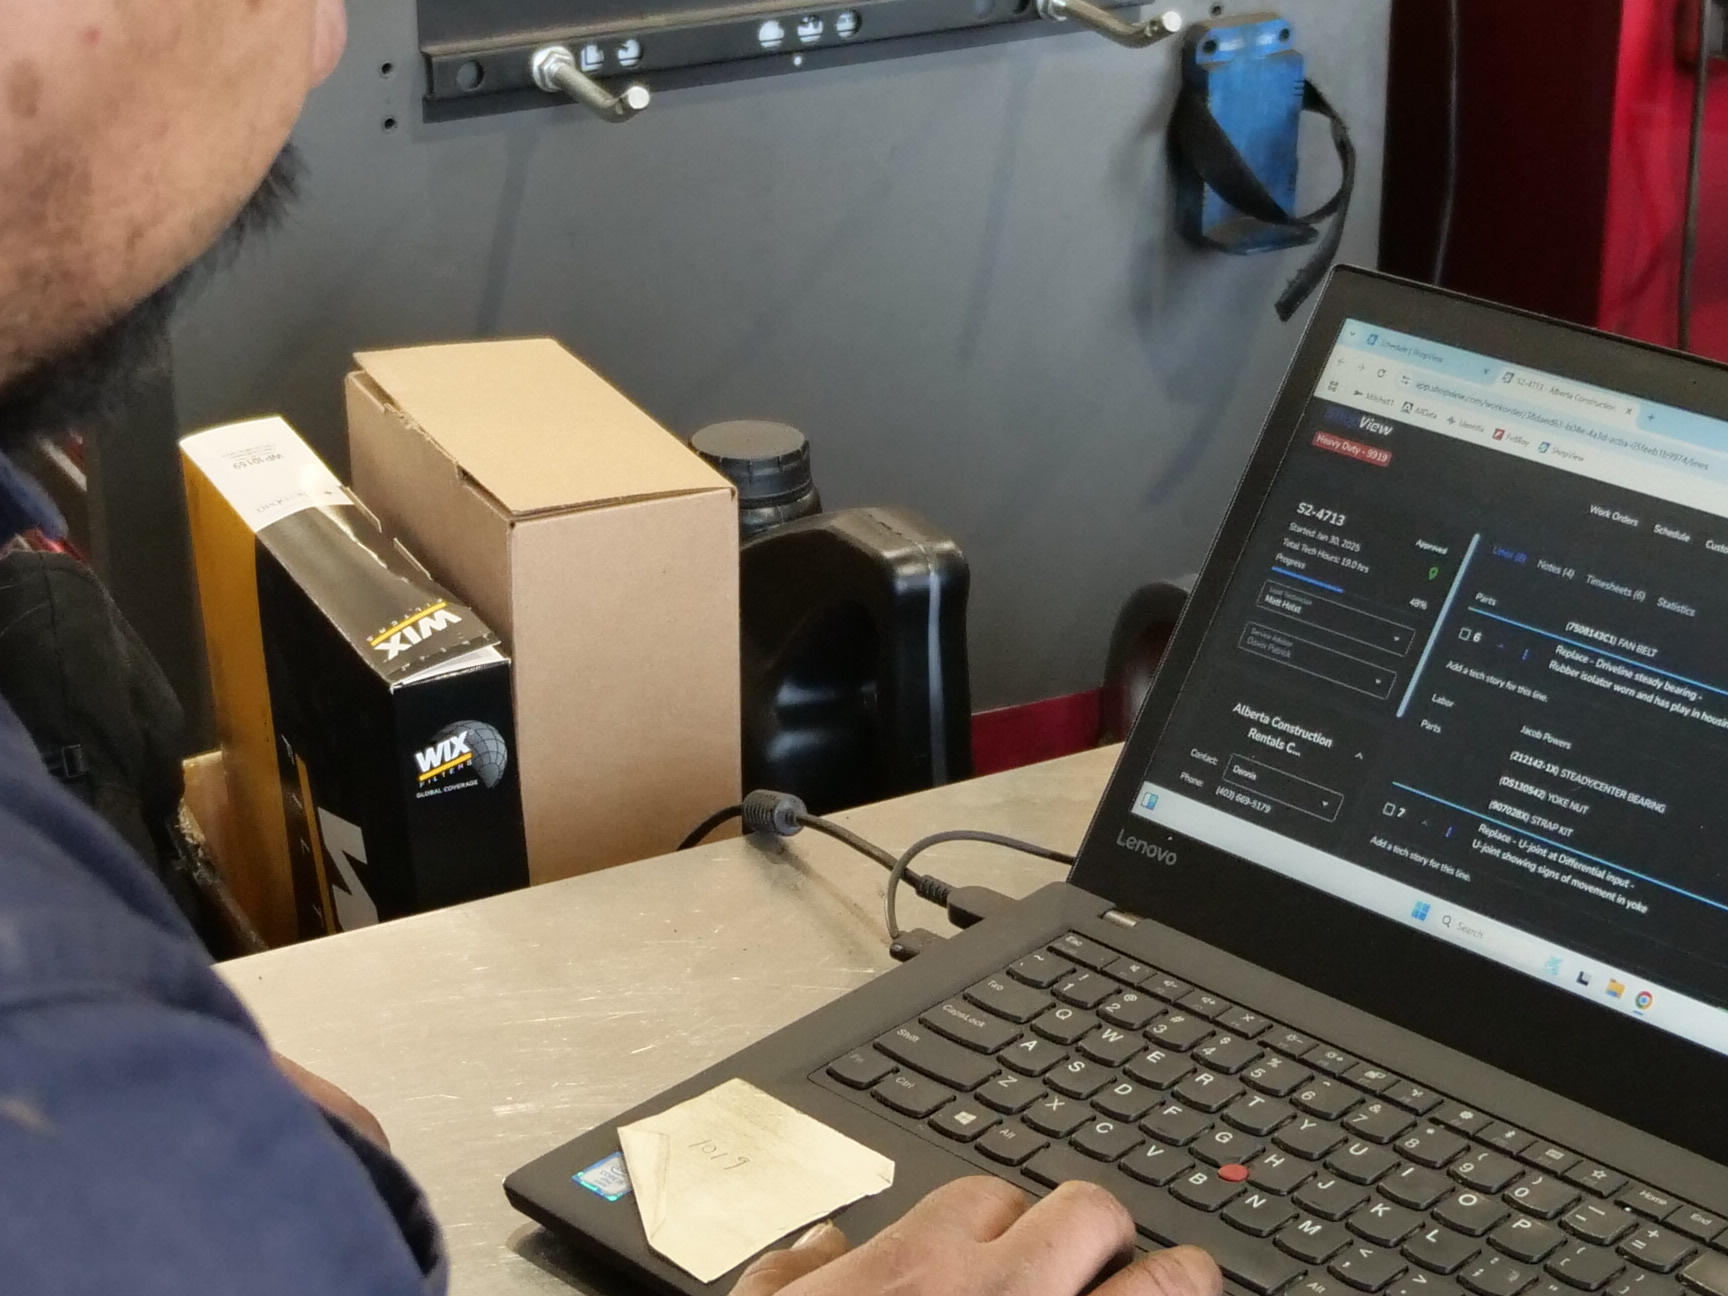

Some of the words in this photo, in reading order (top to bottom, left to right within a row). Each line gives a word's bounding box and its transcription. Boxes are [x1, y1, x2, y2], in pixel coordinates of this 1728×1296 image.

[1548, 386, 1574, 400] Alberta
[1315, 433, 1342, 450] Heavy
[1340, 440, 1361, 456] Duty
[1365, 448, 1389, 463] 9919
[1296, 501, 1346, 527] S2-4713
[1589, 504, 1611, 519] Work
[1611, 510, 1639, 527] Orders
[1315, 531, 1329, 542] Jan
[1340, 538, 1361, 552] 2025
[1653, 523, 1691, 542] Schedule
[1282, 537, 1301, 551] Total
[1300, 543, 1317, 555] Tech
[1316, 549, 1341, 564] Hours:
[1340, 556, 1358, 569] 19.0
[1356, 562, 1370, 574] hrs
[1414, 538, 1448, 555] Approved
[1274, 552, 1306, 570] Progress
[1536, 559, 1562, 575] Notes
[1561, 567, 1575, 580] (4)
[1474, 591, 1497, 606] Parts
[1586, 573, 1633, 597] Timesheets
[1632, 589, 1646, 602] (6)
[1264, 593, 1282, 607] Matt
[1656, 596, 1696, 617] Statistics
[374, 608, 462, 660] WIX
[1617, 637, 1636, 651] FAN
[1635, 643, 1658, 657] BELT
[1445, 660, 1464, 673] Add
[1468, 668, 1486, 681] tech
[1485, 675, 1506, 688] story
[1504, 680, 1517, 691] for
[1516, 684, 1532, 697] this
[1554, 644, 1589, 664] Replace
[1594, 657, 1634, 679] Driveline
[1633, 672, 1664, 690] steady
[1662, 680, 1698, 702] bearing
[1431, 692, 1455, 708] Labor
[1548, 659, 1580, 678] Rubber
[1579, 670, 1613, 689] isolator
[1612, 683, 1636, 697] worn
[1635, 691, 1655, 703] and
[1652, 694, 1671, 709] has
[1668, 702, 1692, 717] play
[1689, 707, 1701, 719] in
[1232, 702, 1270, 725] Alberta
[1270, 715, 1333, 748] Construction
[1420, 718, 1441, 734] Parts
[1247, 727, 1285, 750] Rentals
[1519, 724, 1543, 740] Jacob
[1541, 731, 1572, 750] Powers
[415, 731, 472, 774] WIX
[419, 760, 473, 788] FILTERS
[1232, 764, 1257, 781] Dennis
[1509, 750, 1560, 776] (212142-1X)
[1559, 768, 1628, 799] STEADY/CENTER
[1626, 792, 1666, 814] BEARING
[416, 787, 443, 799] GLOBAL
[443, 778, 479, 793] COVERAGE
[1214, 785, 1236, 801] (403)
[1547, 792, 1570, 808] YOKE
[1568, 800, 1589, 814] NUT
[1530, 814, 1560, 831] STRAP
[1557, 825, 1574, 837] KIT
[1116, 829, 1178, 867] Lenovo
[1369, 835, 1388, 849] Add
[1392, 844, 1409, 858] tech
[1408, 851, 1429, 866] story
[1428, 857, 1441, 869] for
[1439, 863, 1455, 875] this
[1477, 822, 1512, 844] Replace
[1517, 838, 1548, 858] U-joint
[1546, 851, 1559, 862] at
[1557, 853, 1607, 880] Differential
[1605, 871, 1630, 889] input
[1471, 838, 1502, 858] U-joint
[1500, 851, 1538, 873] showing
[1536, 864, 1561, 880] signs
[1559, 874, 1572, 884] of
[1569, 878, 1617, 902] movement
[1615, 893, 1626, 905] in
[1625, 899, 1648, 914] yoke
[1456, 921, 1484, 939] Search
[942, 1003, 987, 1029] CapsLock
[896, 1026, 920, 1044] Shift
[1639, 1189, 1668, 1207] Home
